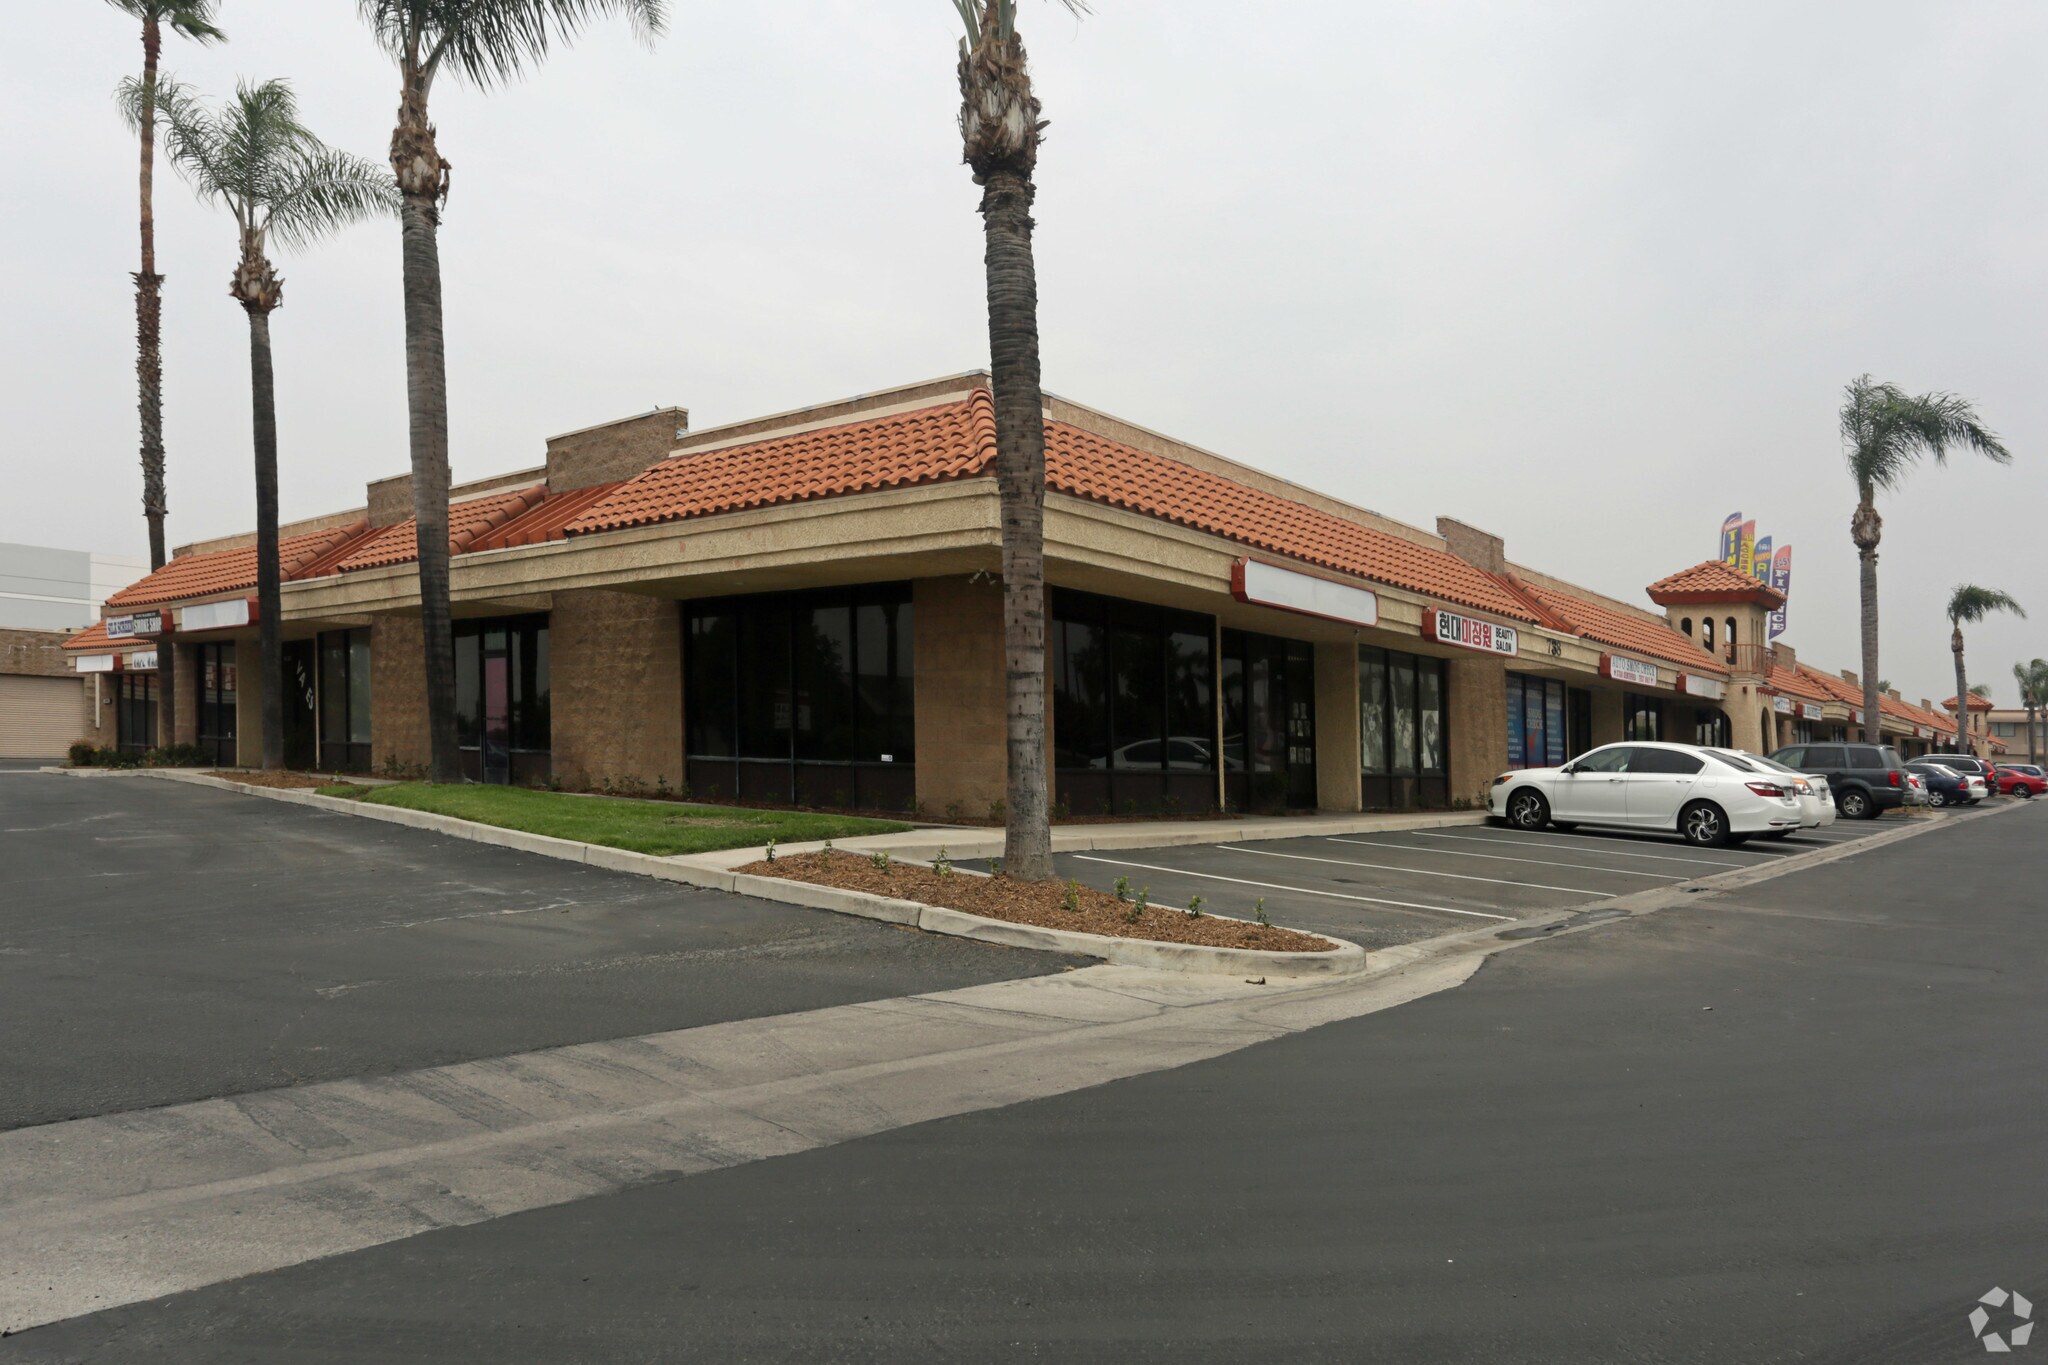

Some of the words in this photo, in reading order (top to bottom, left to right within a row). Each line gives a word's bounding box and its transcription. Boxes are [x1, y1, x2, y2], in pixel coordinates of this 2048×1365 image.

[1440, 612, 1491, 648] 현대미장원
[1496, 628, 1513, 641] BEAUTY
[1496, 640, 1511, 652] SALON
[1612, 656, 1625, 669] AUTO
[1627, 659, 1640, 673] SMOG
[1641, 663, 1654, 676] CHECK
